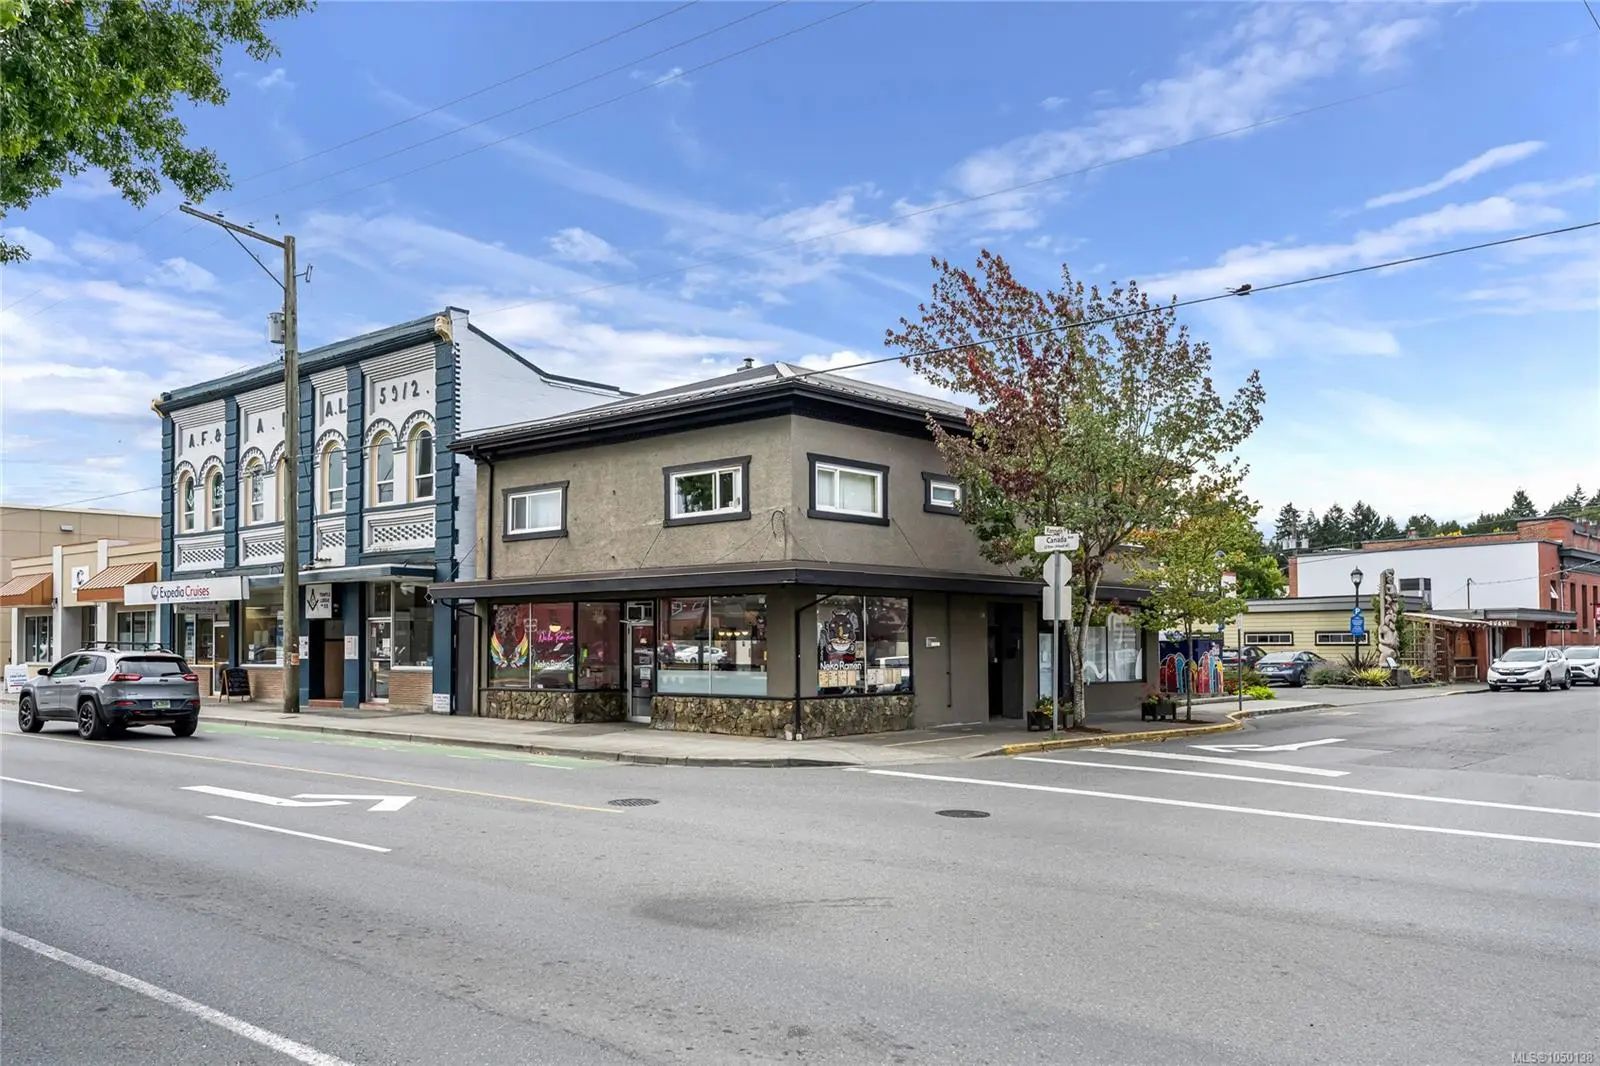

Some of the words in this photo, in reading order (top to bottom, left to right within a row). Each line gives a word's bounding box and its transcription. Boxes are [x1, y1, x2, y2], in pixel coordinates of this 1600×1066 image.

[1046, 536, 1067, 544] Canada
[160, 586, 184, 602] Expedia
[185, 585, 210, 598] Cruises
[820, 661, 839, 670] Neko
[840, 661, 862, 670] Ramen
